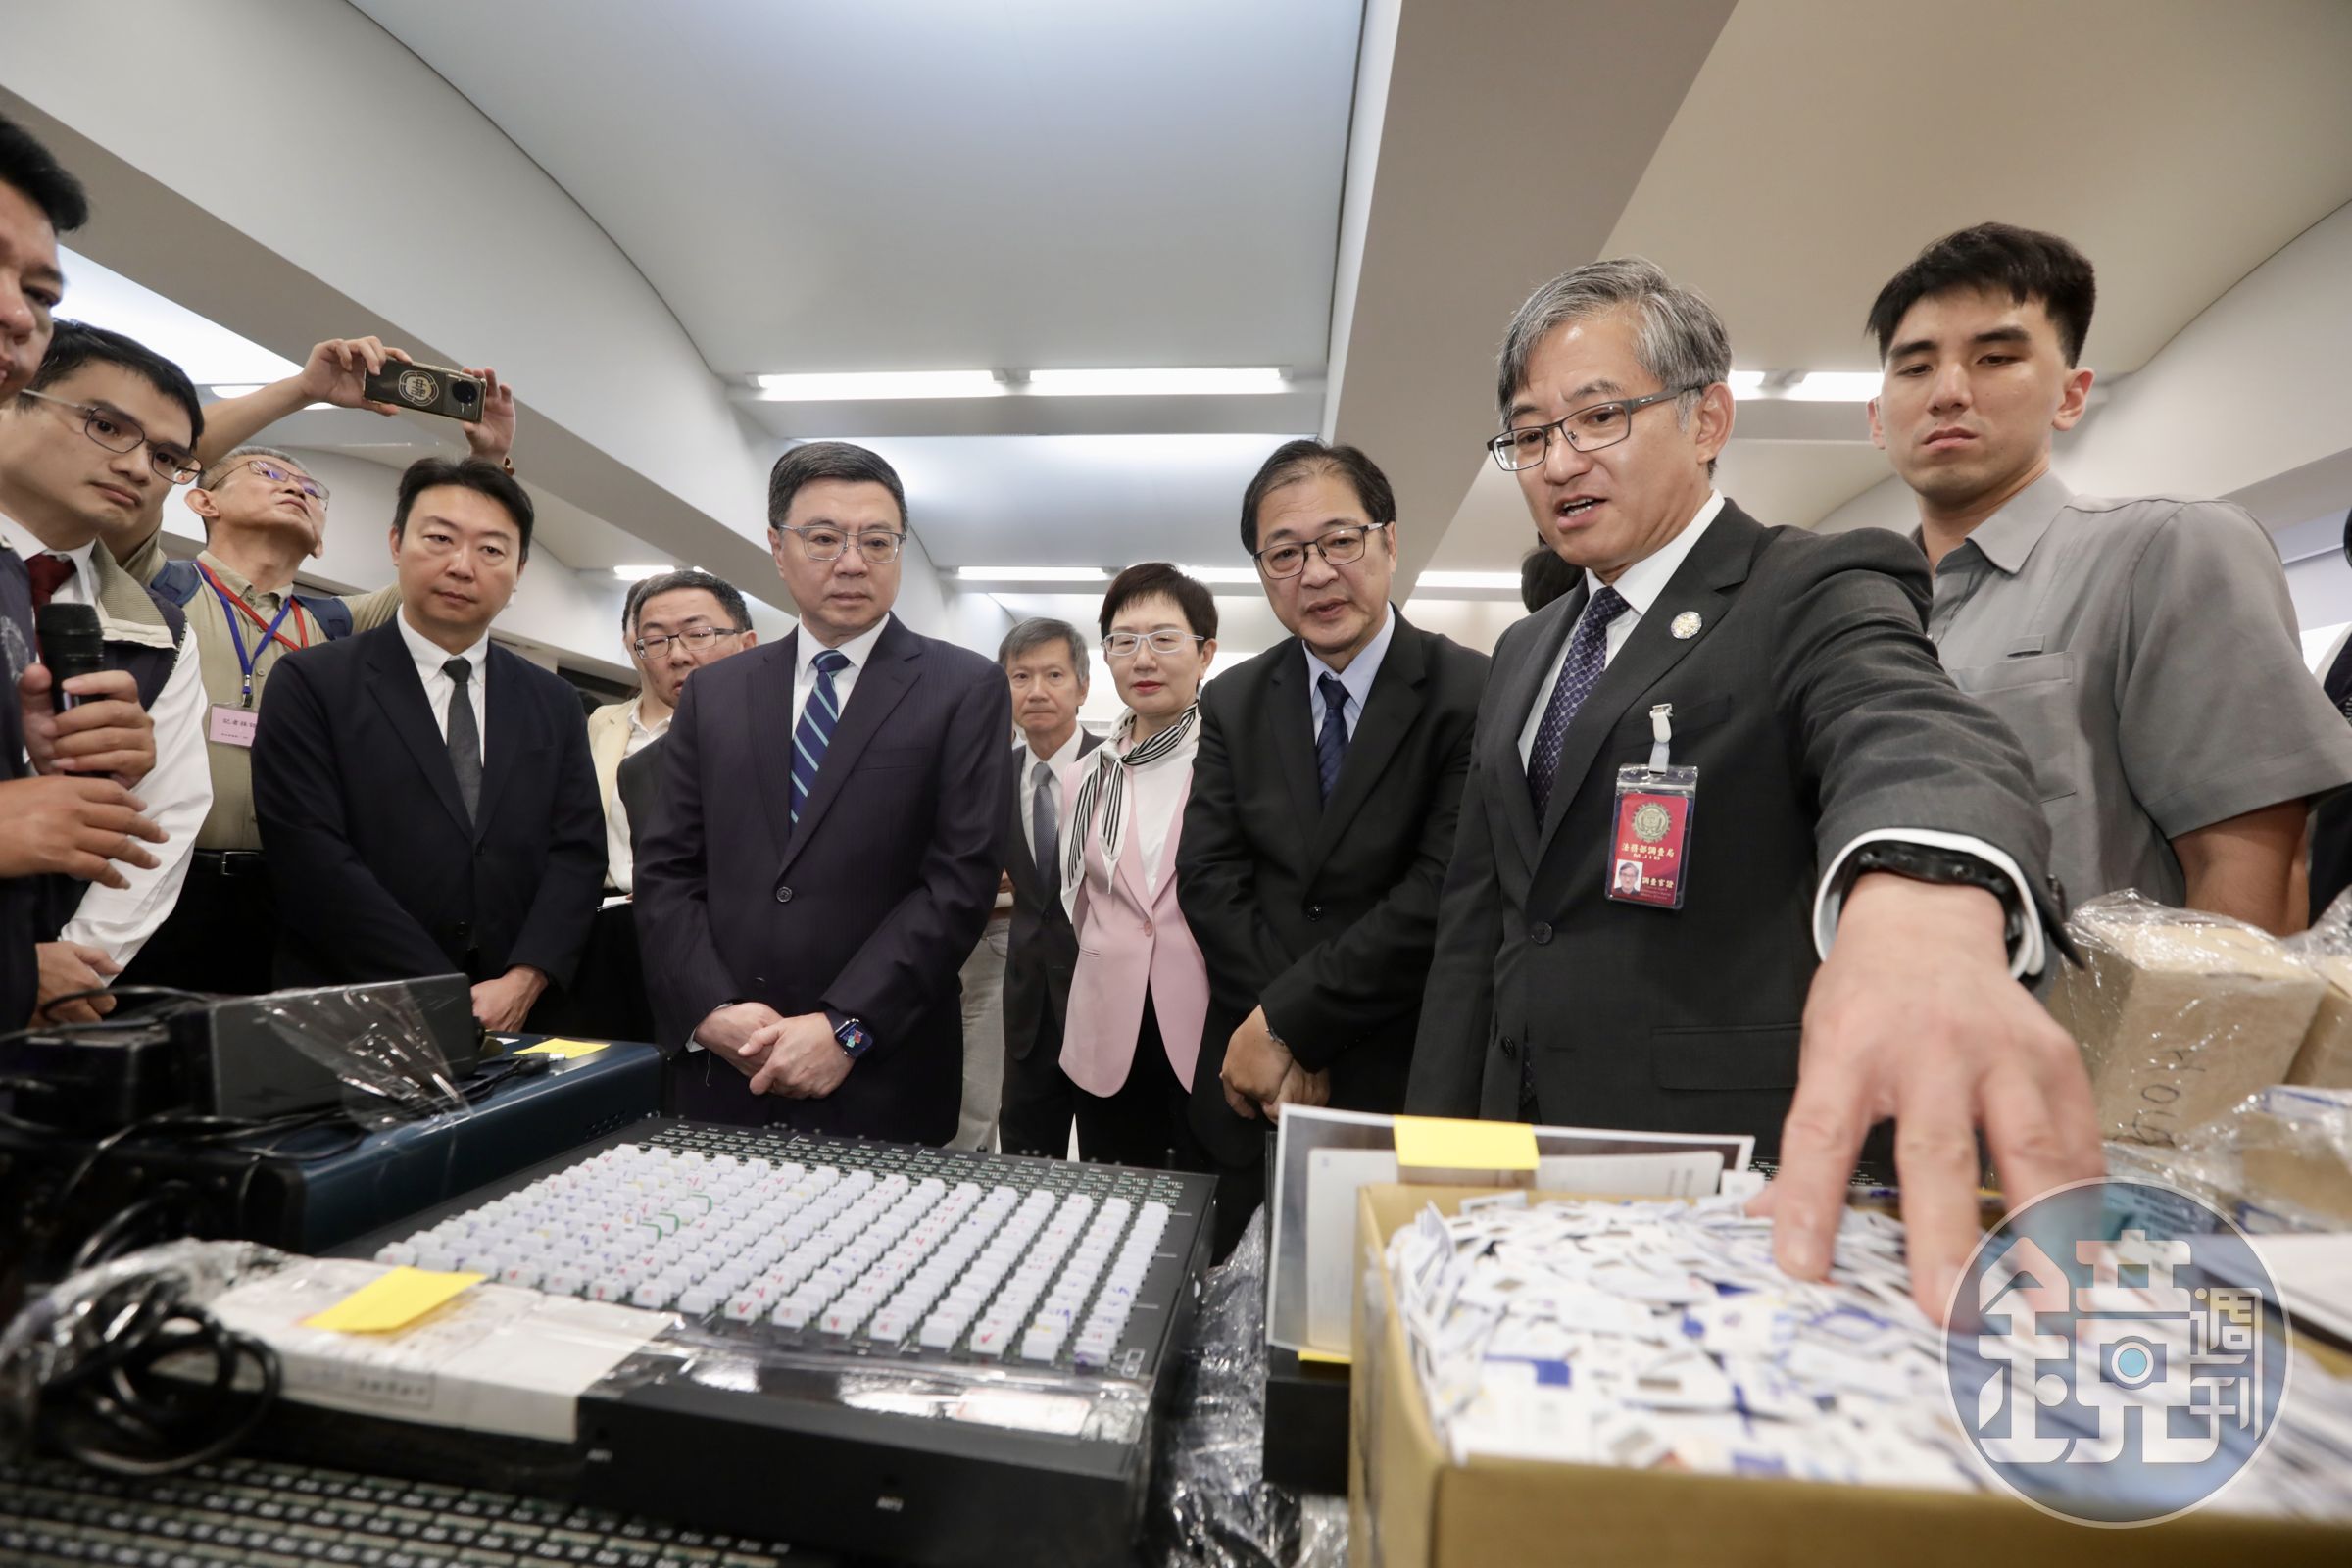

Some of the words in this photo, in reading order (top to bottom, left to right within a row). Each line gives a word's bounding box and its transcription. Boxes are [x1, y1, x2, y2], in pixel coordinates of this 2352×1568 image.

[1622, 842, 1675, 858] 法務部調查局
